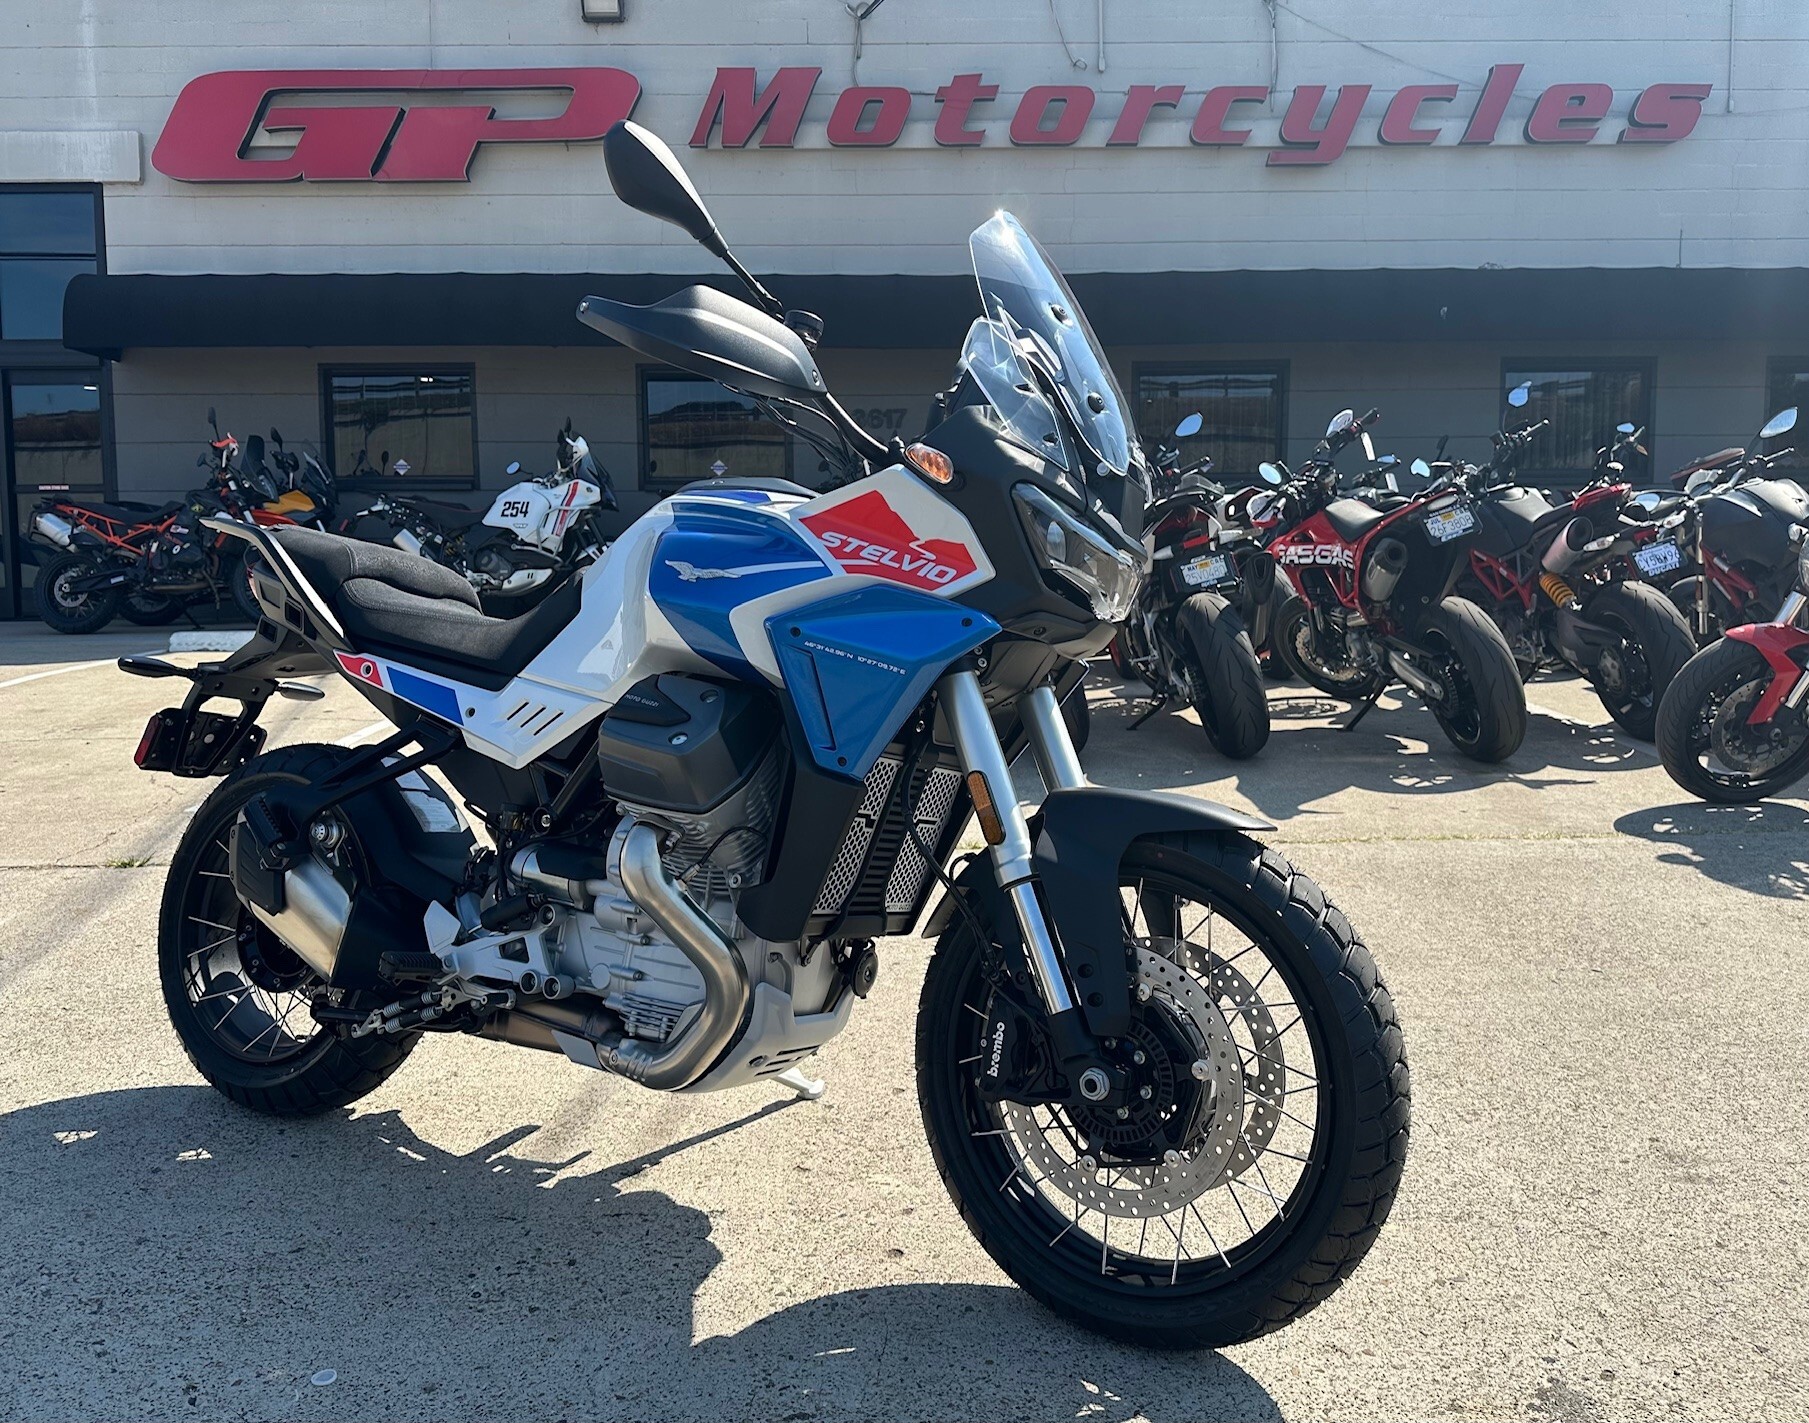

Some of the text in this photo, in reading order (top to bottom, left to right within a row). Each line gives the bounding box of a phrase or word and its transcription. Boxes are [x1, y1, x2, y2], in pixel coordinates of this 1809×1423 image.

[151, 63, 1713, 183] GP Motorcycles
[501, 501, 530, 518] 254
[1430, 515, 1473, 536] 26F3808
[821, 531, 957, 583] STELVIO
[1187, 563, 1198, 571] MAY
[1648, 562, 1680, 577] DUCATI
[987, 1021, 1005, 1077] brembo
